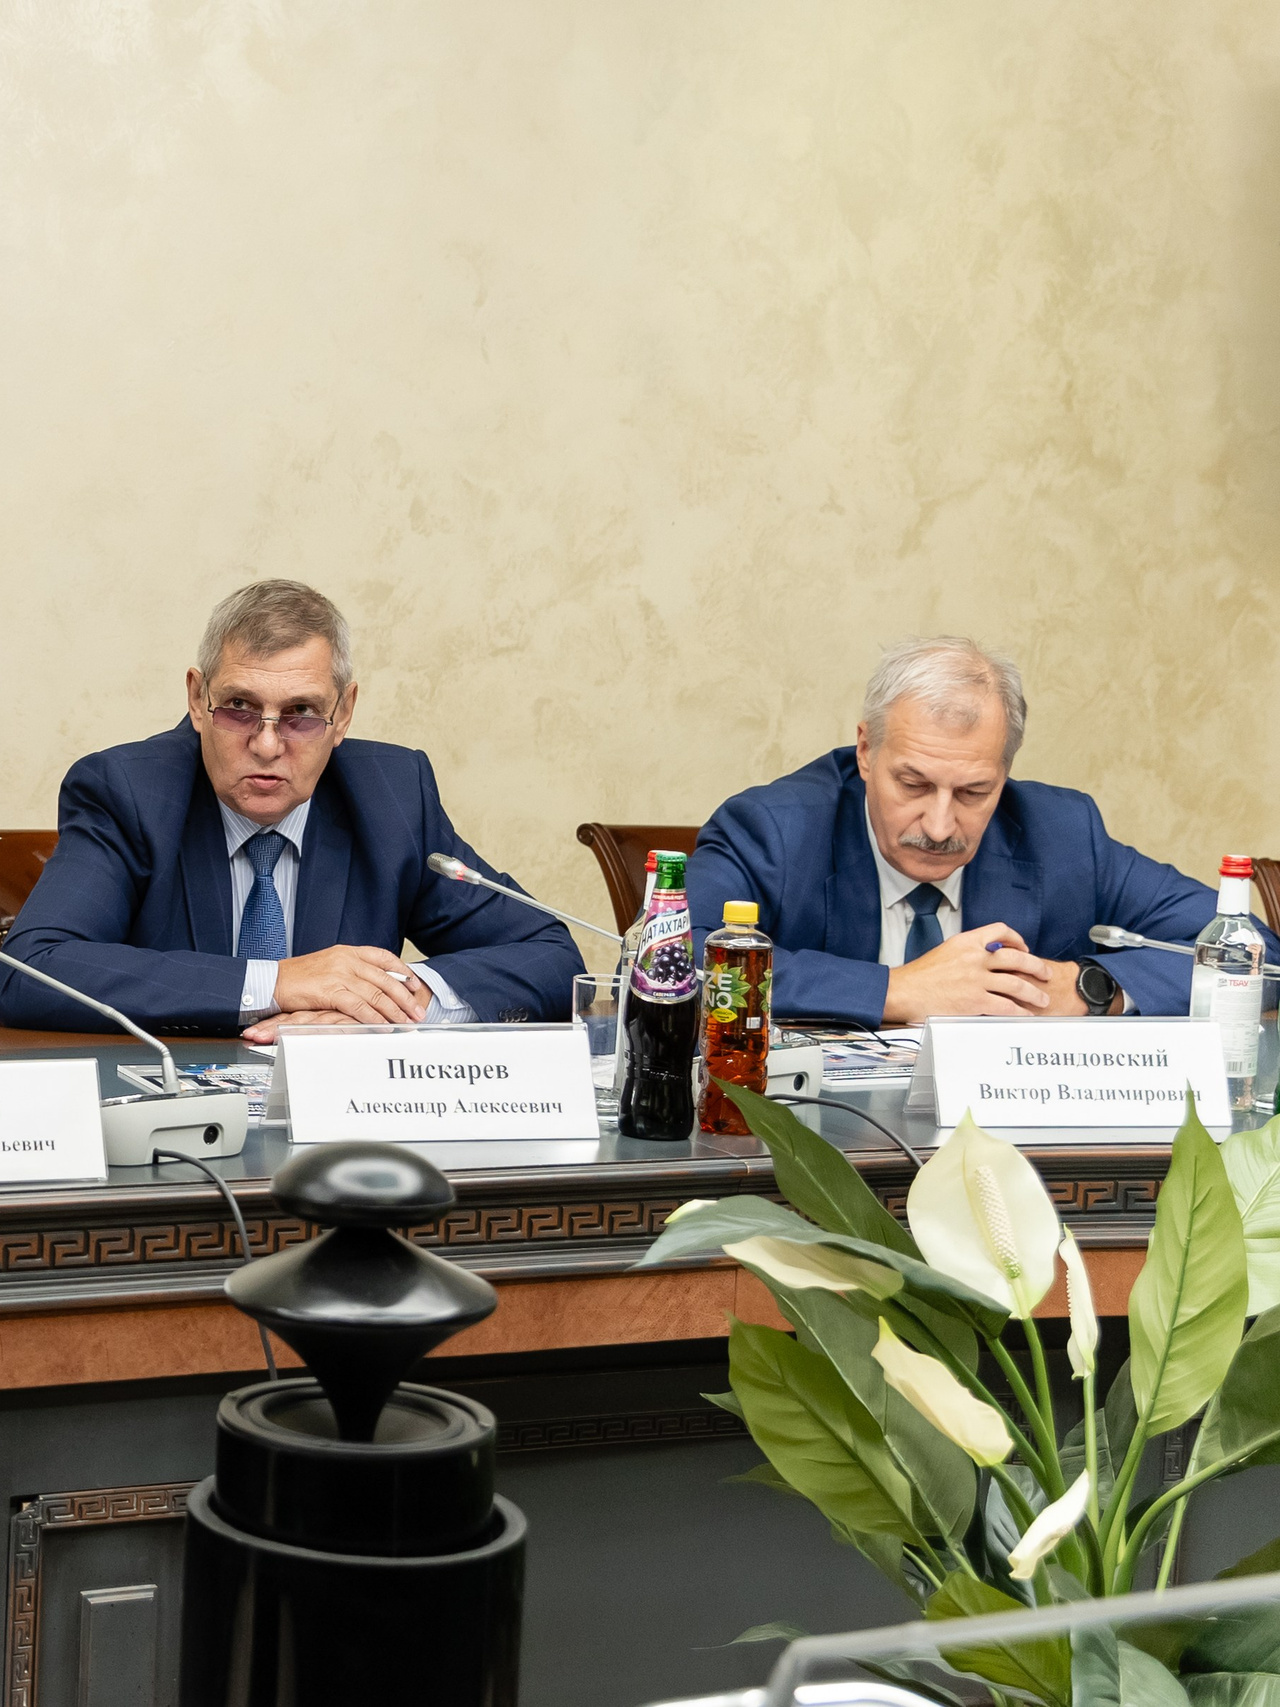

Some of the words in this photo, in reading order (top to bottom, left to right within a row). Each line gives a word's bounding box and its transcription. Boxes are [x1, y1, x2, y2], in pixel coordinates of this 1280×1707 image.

[1004, 1046, 1170, 1068] Левандовский
[385, 1057, 511, 1086] Пискарев
[978, 1083, 1052, 1105] Виктор
[344, 1097, 448, 1118] Александр
[453, 1097, 564, 1115] Алексеевич
